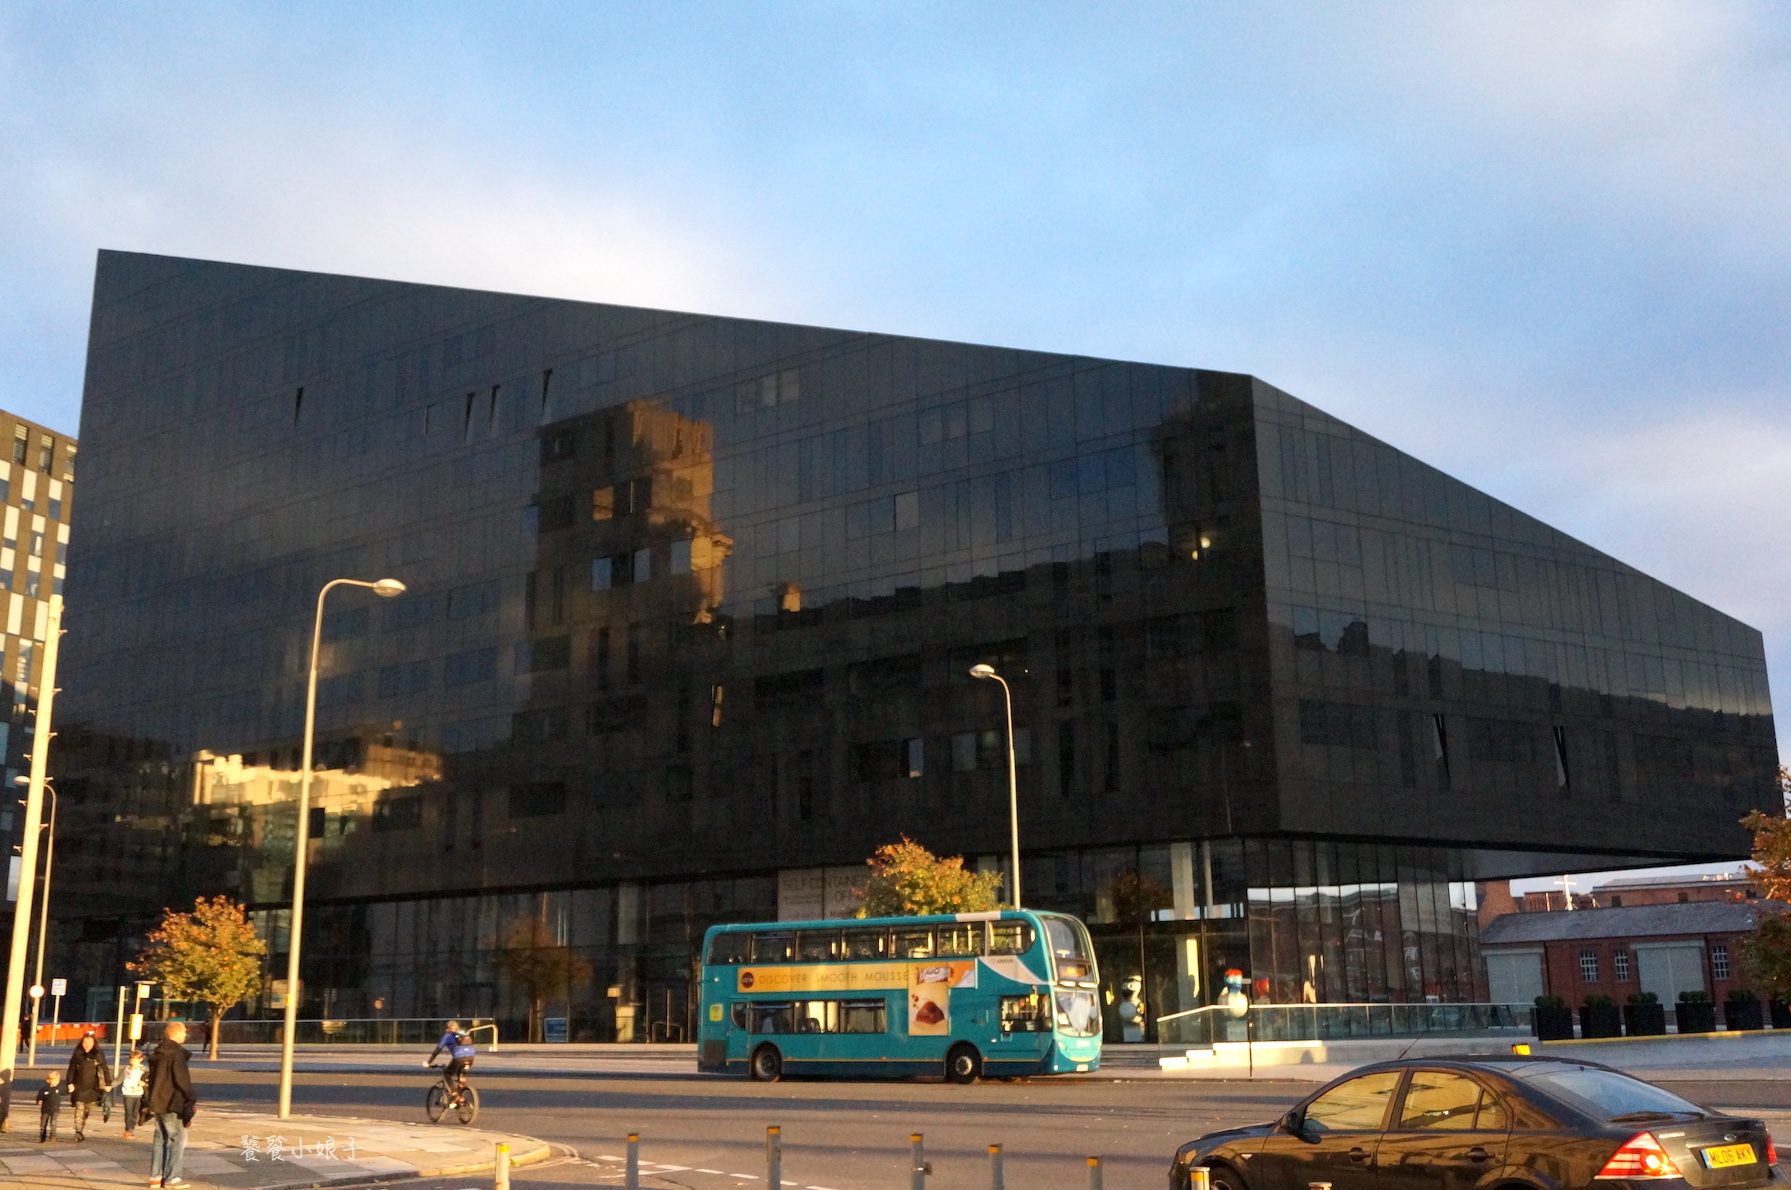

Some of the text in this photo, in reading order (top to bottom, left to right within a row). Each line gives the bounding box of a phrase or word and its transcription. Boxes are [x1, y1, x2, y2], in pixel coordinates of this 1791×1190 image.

[758, 970, 908, 985] DISCOVER SMOOTH MOUSSE
[1708, 1147, 1753, 1165] ML06 AKY
